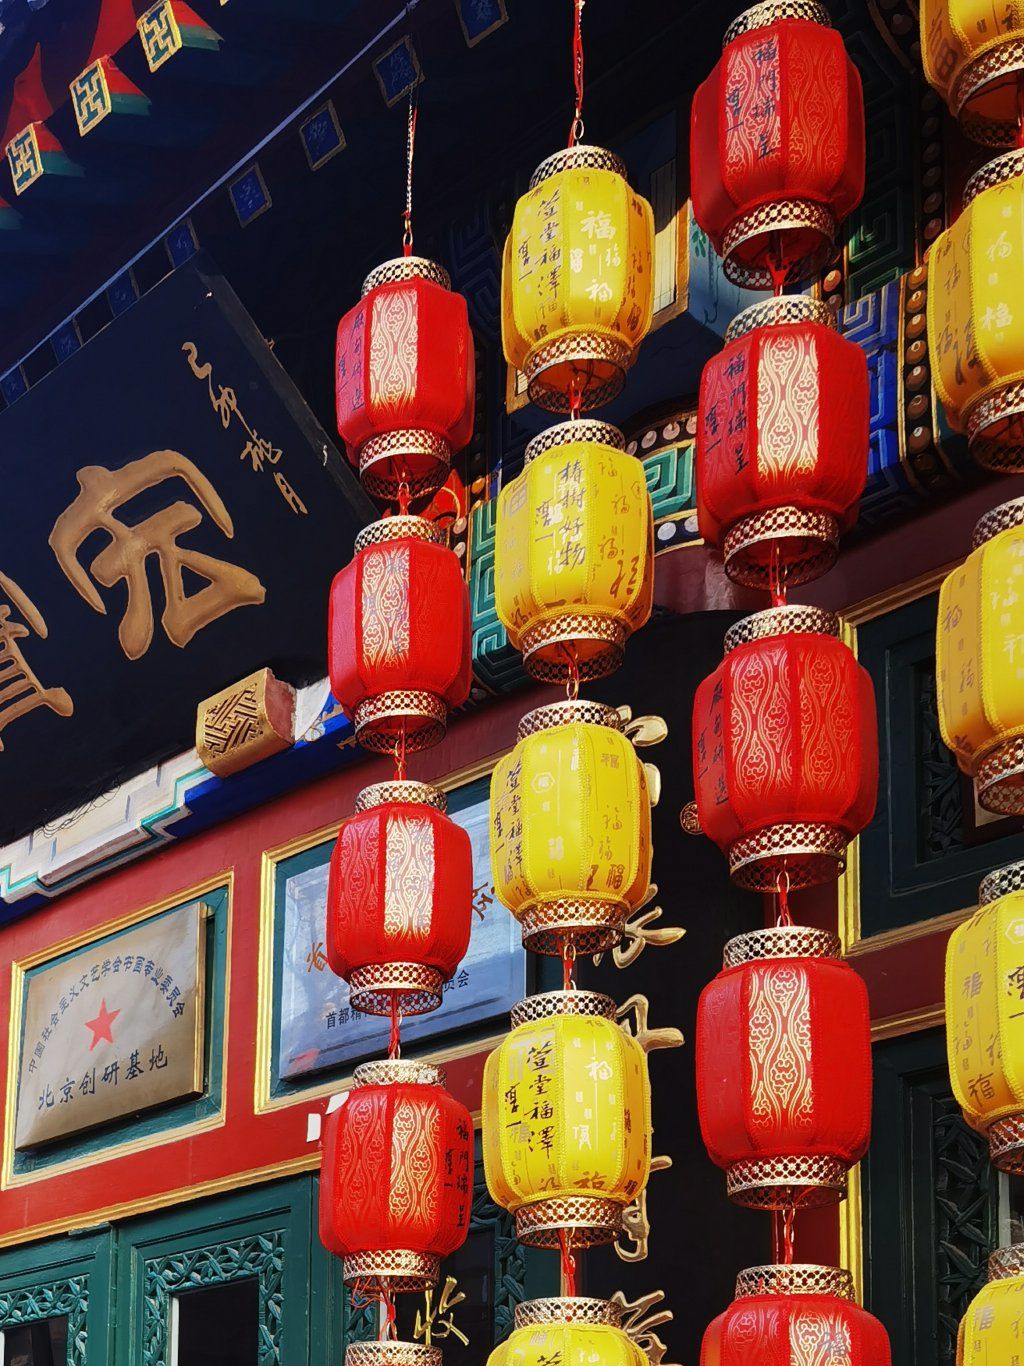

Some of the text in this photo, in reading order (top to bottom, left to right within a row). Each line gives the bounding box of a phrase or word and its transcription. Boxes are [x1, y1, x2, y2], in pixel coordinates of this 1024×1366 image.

[38, 1044, 169, 1111] 北京创研基地
[524, 1040, 555, 1159] 萱堂福澤
